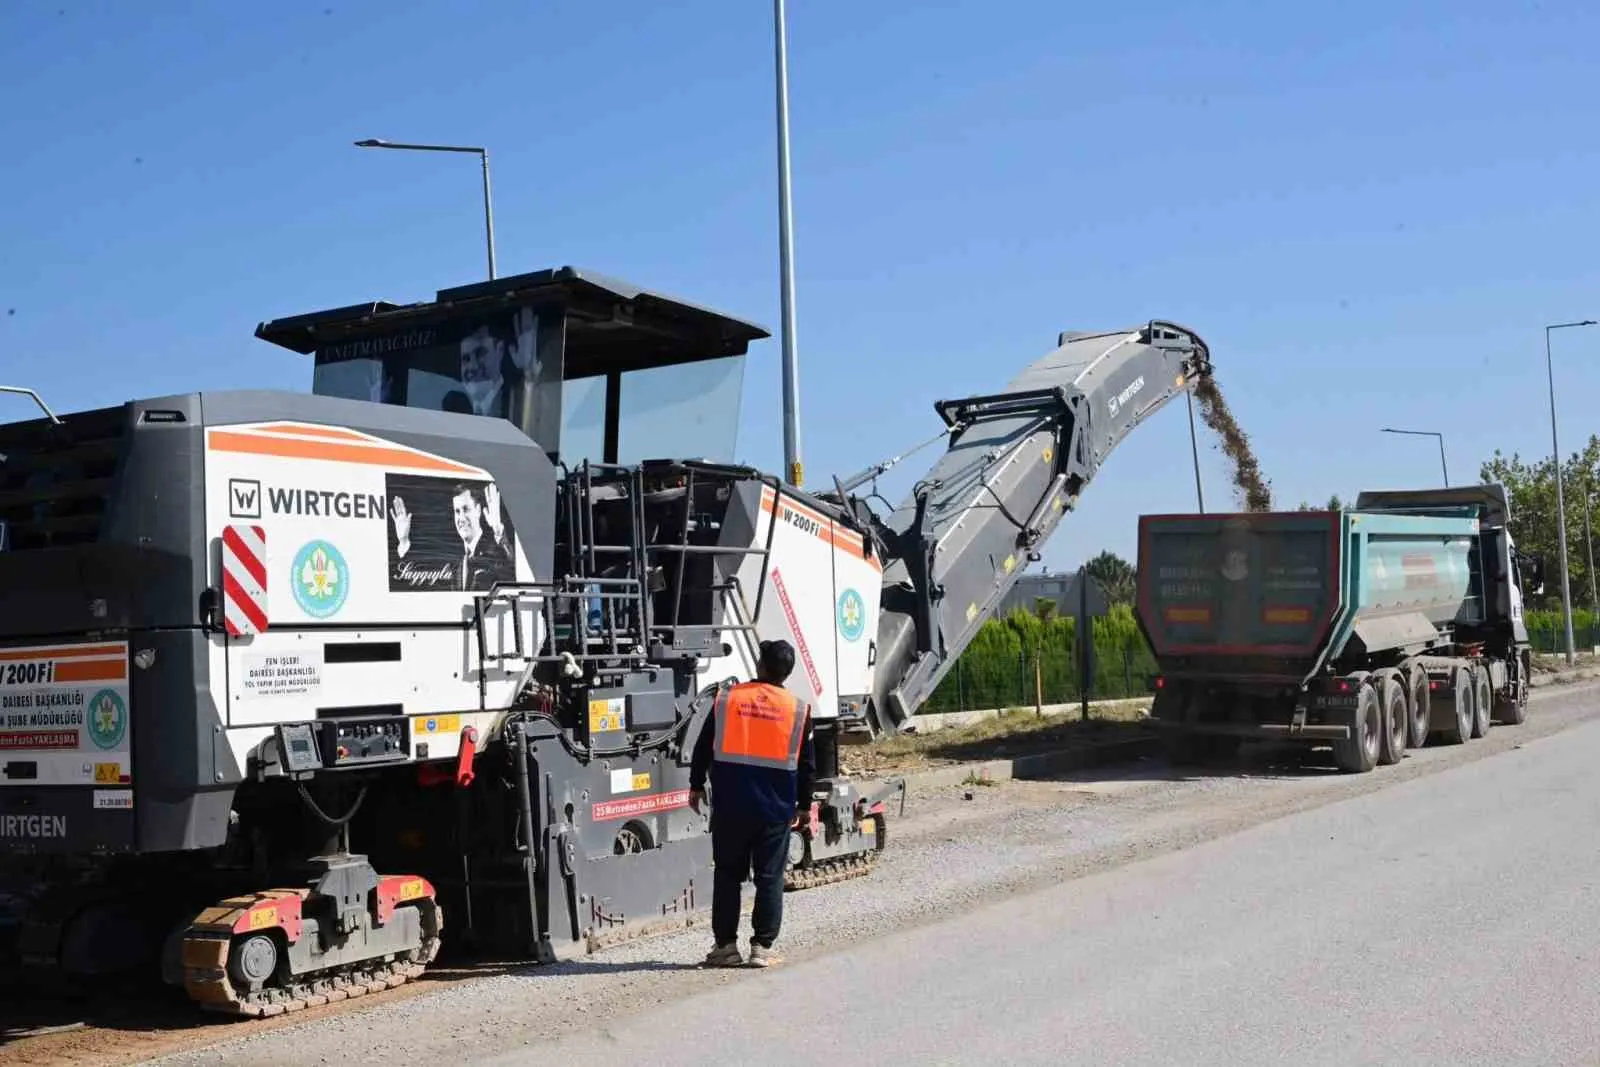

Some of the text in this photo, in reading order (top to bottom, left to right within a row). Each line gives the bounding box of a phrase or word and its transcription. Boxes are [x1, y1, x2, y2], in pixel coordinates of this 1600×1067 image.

[268, 487, 385, 519] WIRTGEN
[784, 507, 820, 537] W 200Fi
[7, 661, 53, 684] 200Fi
[0, 815, 66, 837] IRTGEN
